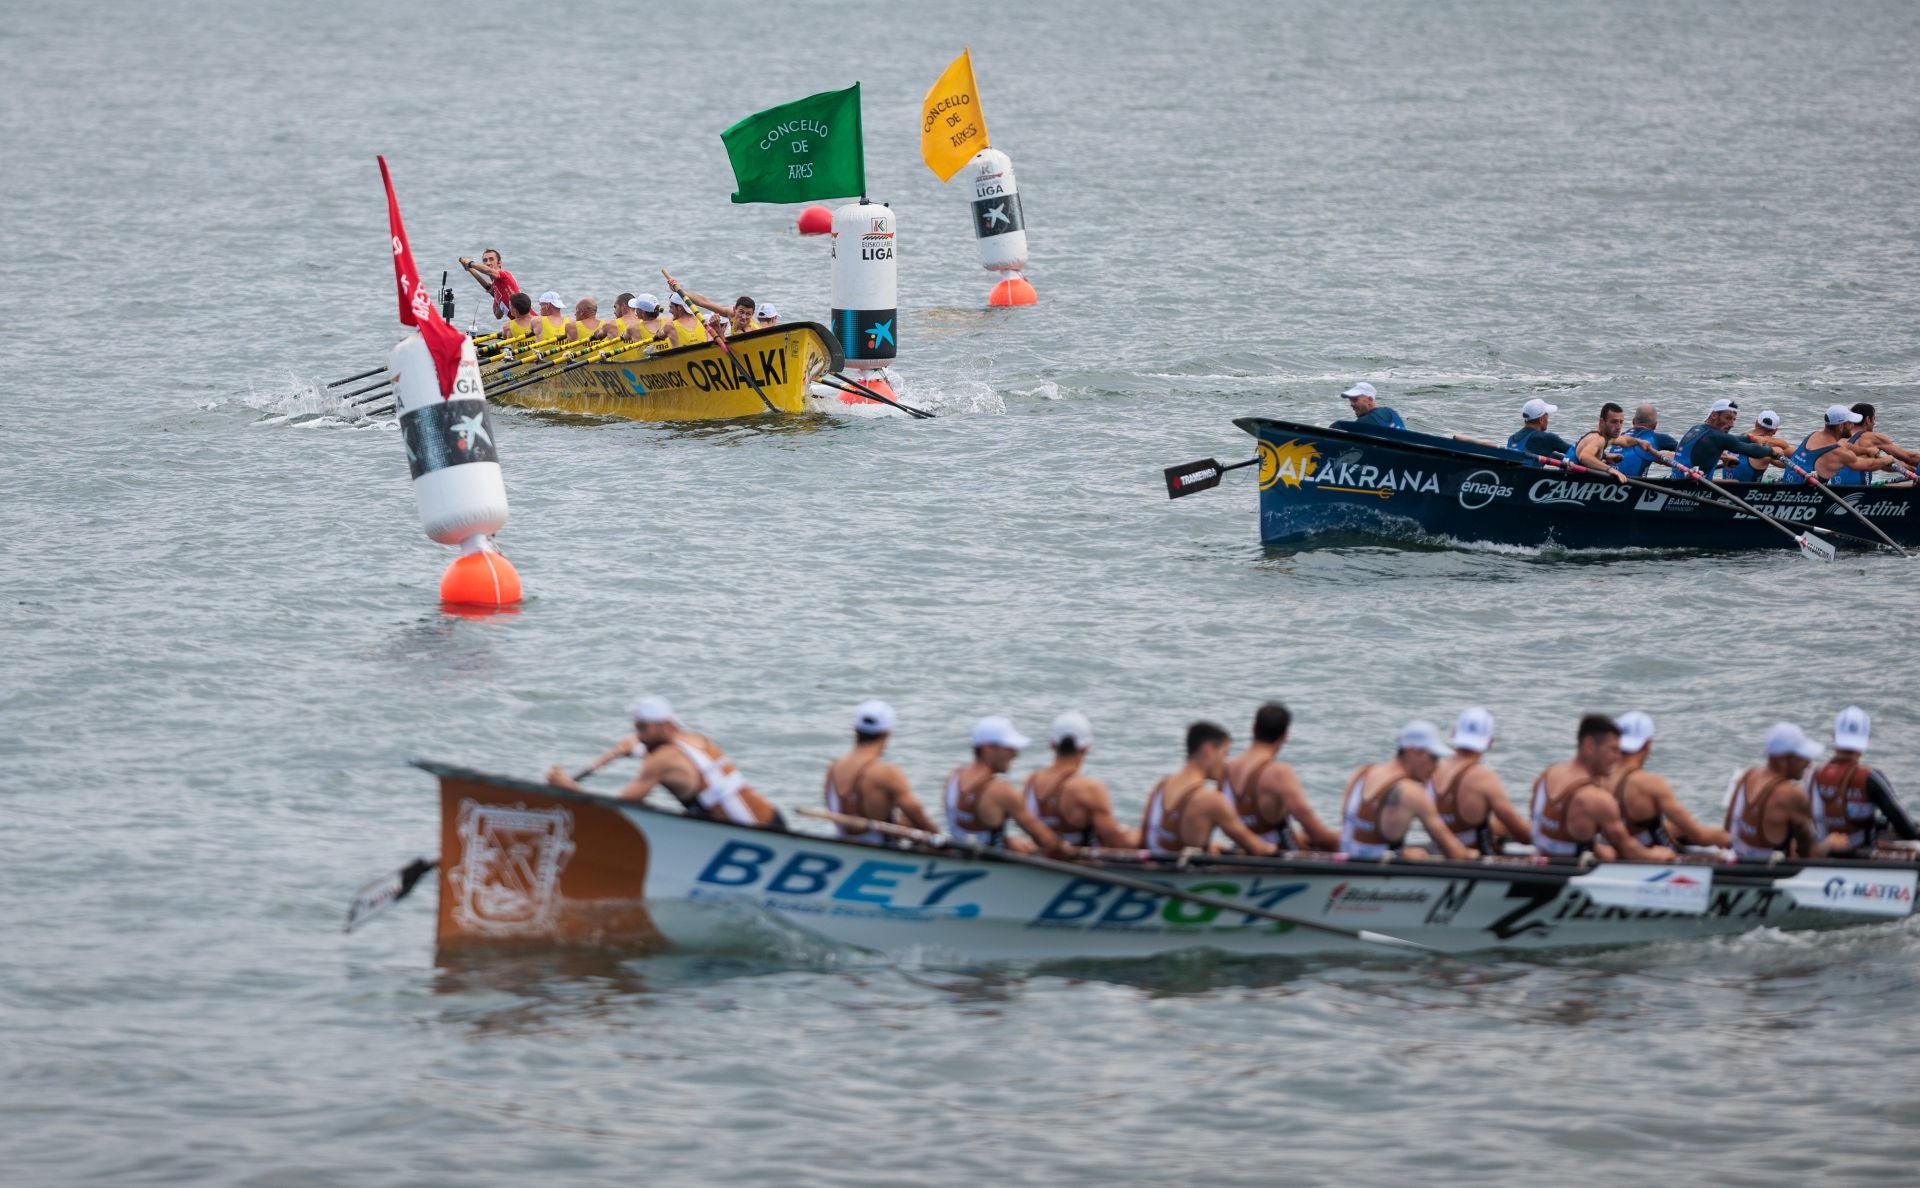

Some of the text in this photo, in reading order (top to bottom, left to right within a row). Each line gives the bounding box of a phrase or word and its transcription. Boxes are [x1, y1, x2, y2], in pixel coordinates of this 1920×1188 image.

[924, 94, 970, 133] CONCELLO
[946, 112, 962, 128] DE
[760, 119, 828, 150] CONCELLO
[950, 123, 977, 148] ARES
[791, 140, 809, 153] DE
[787, 162, 813, 179] ARES
[976, 184, 1004, 198] LIGA
[862, 247, 893, 261] LIGA
[686, 348, 788, 393] ORIALKI
[639, 370, 688, 393] ORBINOX
[1276, 456, 1440, 494] ALAKRANA
[1461, 479, 1514, 498] enagas
[1528, 478, 1632, 504] CAMPOS
[1744, 488, 1824, 503] Bou Bizkaia
[1853, 500, 1911, 518] satlink
[1853, 883, 1911, 902] MATRA
